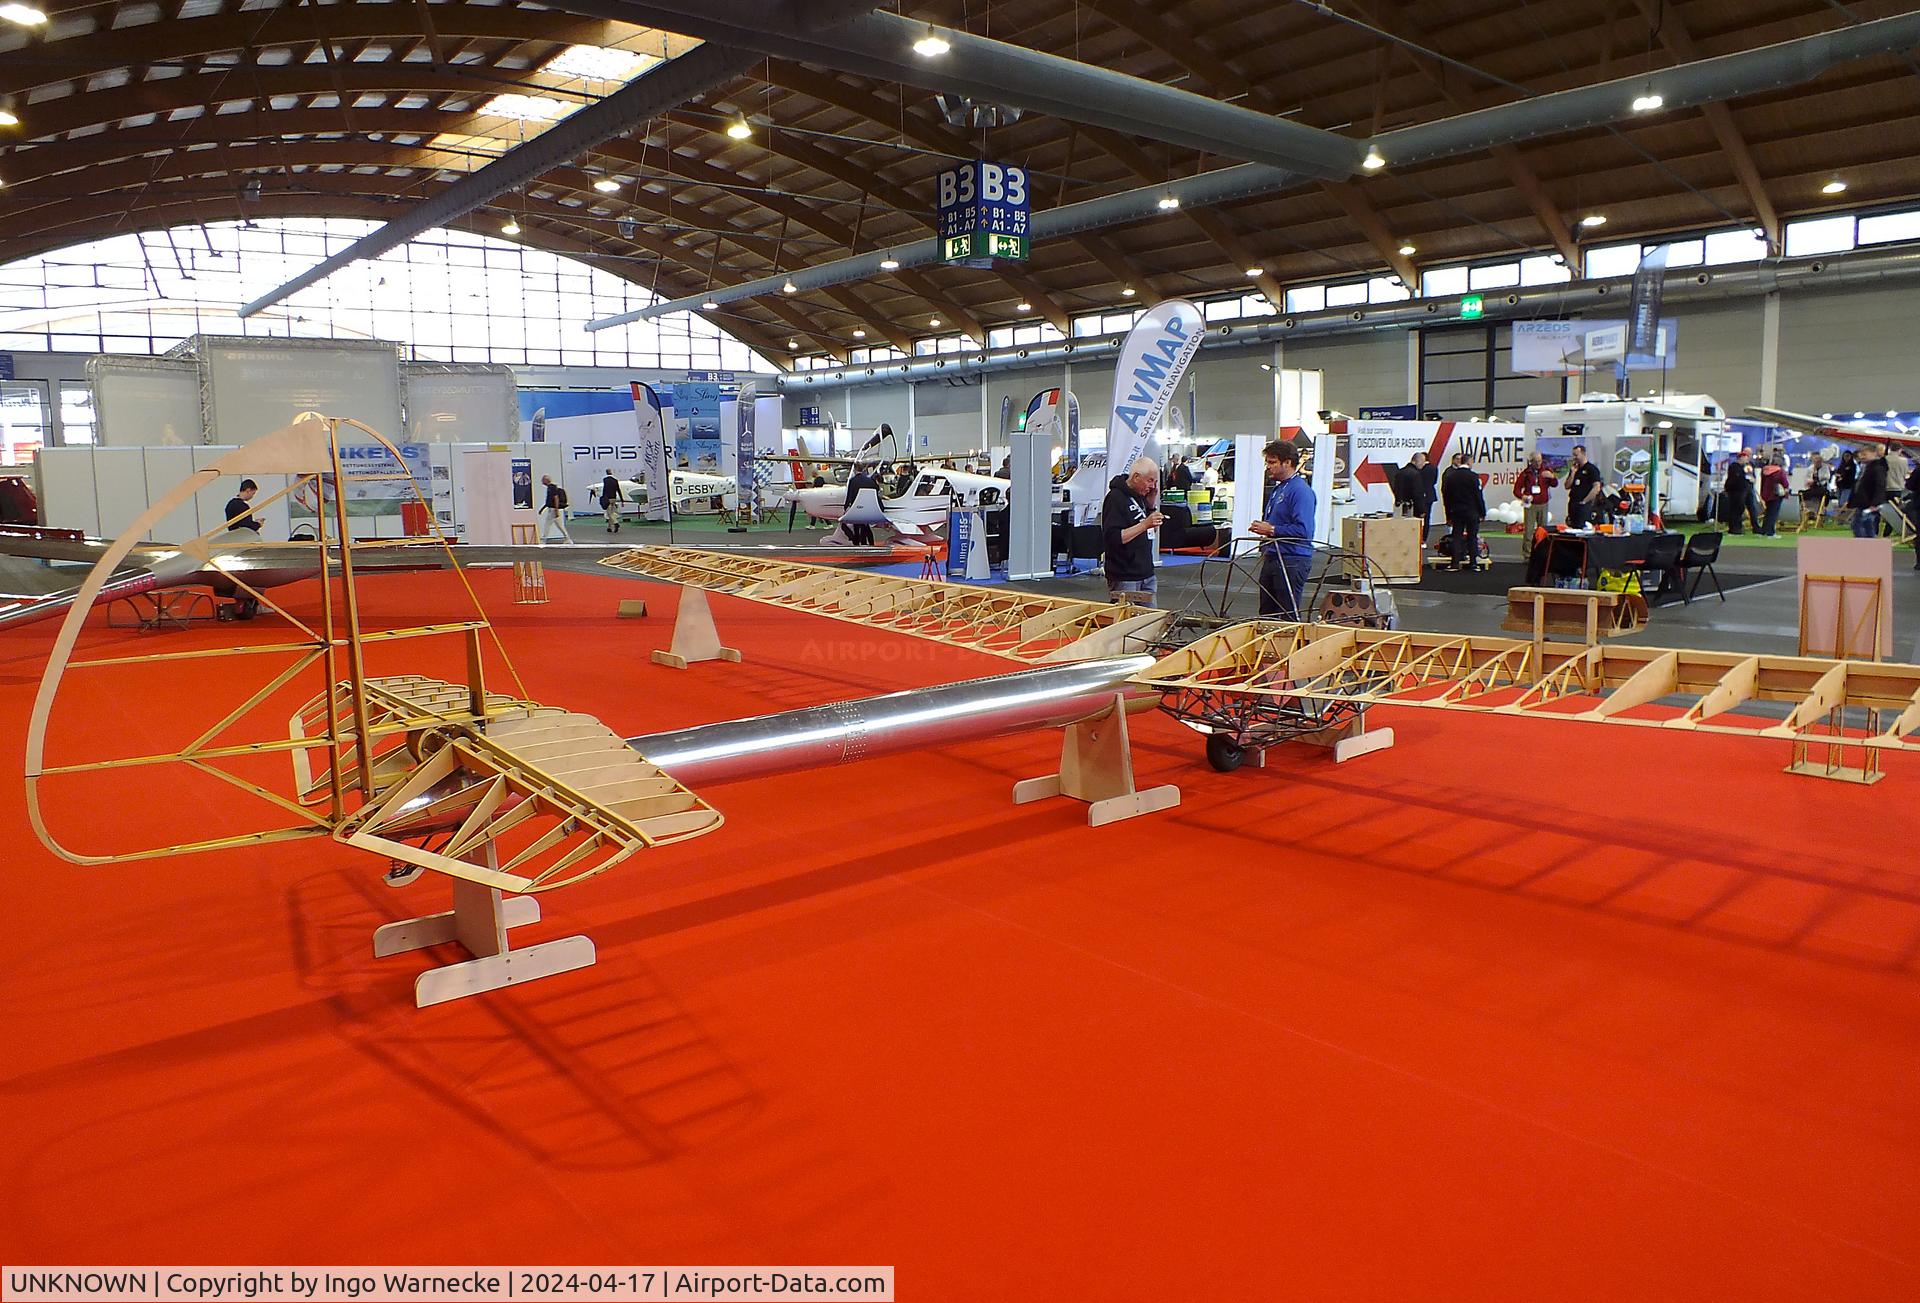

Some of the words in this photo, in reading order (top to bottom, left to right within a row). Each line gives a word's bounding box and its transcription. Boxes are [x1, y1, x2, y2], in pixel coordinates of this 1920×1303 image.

[941, 164, 975, 209] B3
[982, 163, 1026, 206] B3
[948, 211, 958, 223] B1
[965, 207, 976, 218] B5
[992, 207, 1005, 219] B1
[1014, 210, 1026, 223] B5
[947, 223, 958, 236] A1
[964, 219, 976, 231] A7
[991, 219, 1005, 232] A1
[1012, 222, 1026, 234] A7
[1140, 389, 1170, 440] SATELLITE
[1168, 327, 1205, 390] NAVIGATION
[1357, 437, 1387, 449] DISCOVER
[1387, 438, 1400, 449] OUR
[1401, 438, 1426, 449] PASSION
[1459, 436, 1524, 463] WARTE
[675, 484, 715, 495] D-ESBY
